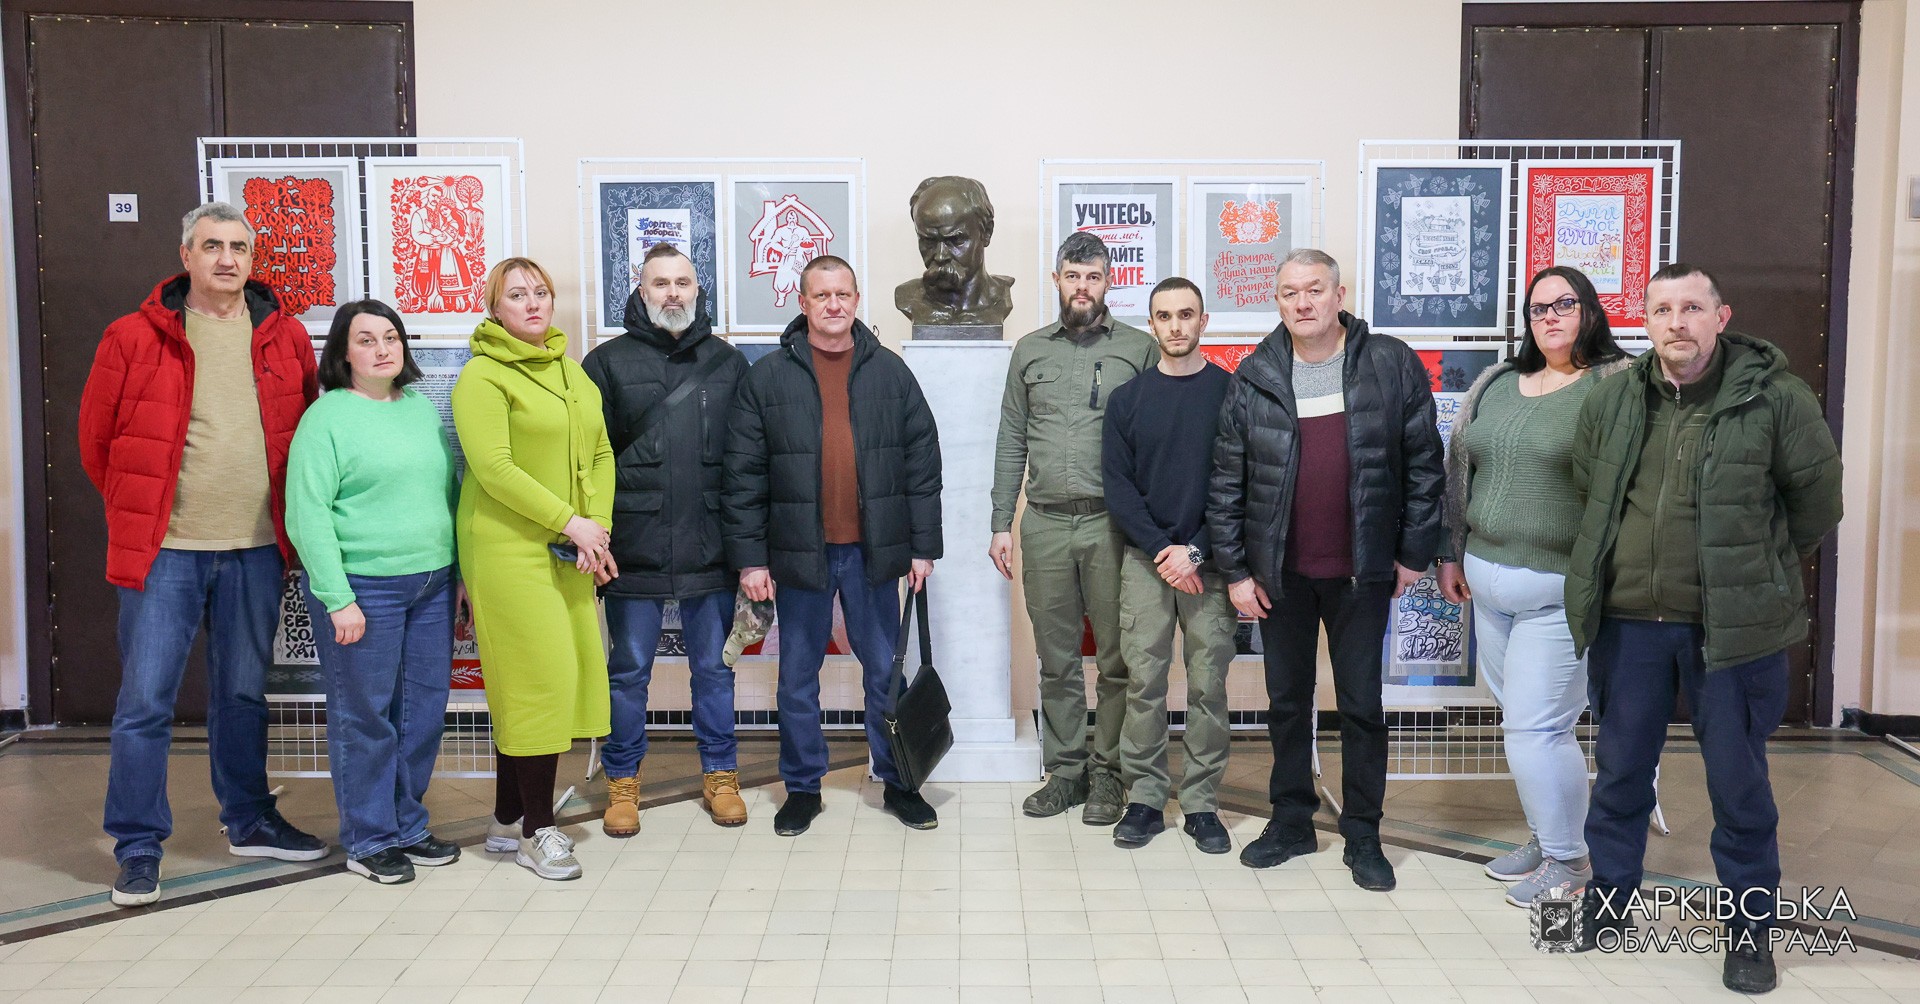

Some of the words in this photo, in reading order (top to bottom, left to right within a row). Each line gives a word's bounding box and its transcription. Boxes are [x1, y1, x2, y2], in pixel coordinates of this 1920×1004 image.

[115, 203, 132, 213] 39
[1075, 202, 1156, 226] УЧІТЕСЬ,
[1107, 245, 1144, 263] АЙТЕ
[1110, 264, 1156, 286] АЙТЕ...
